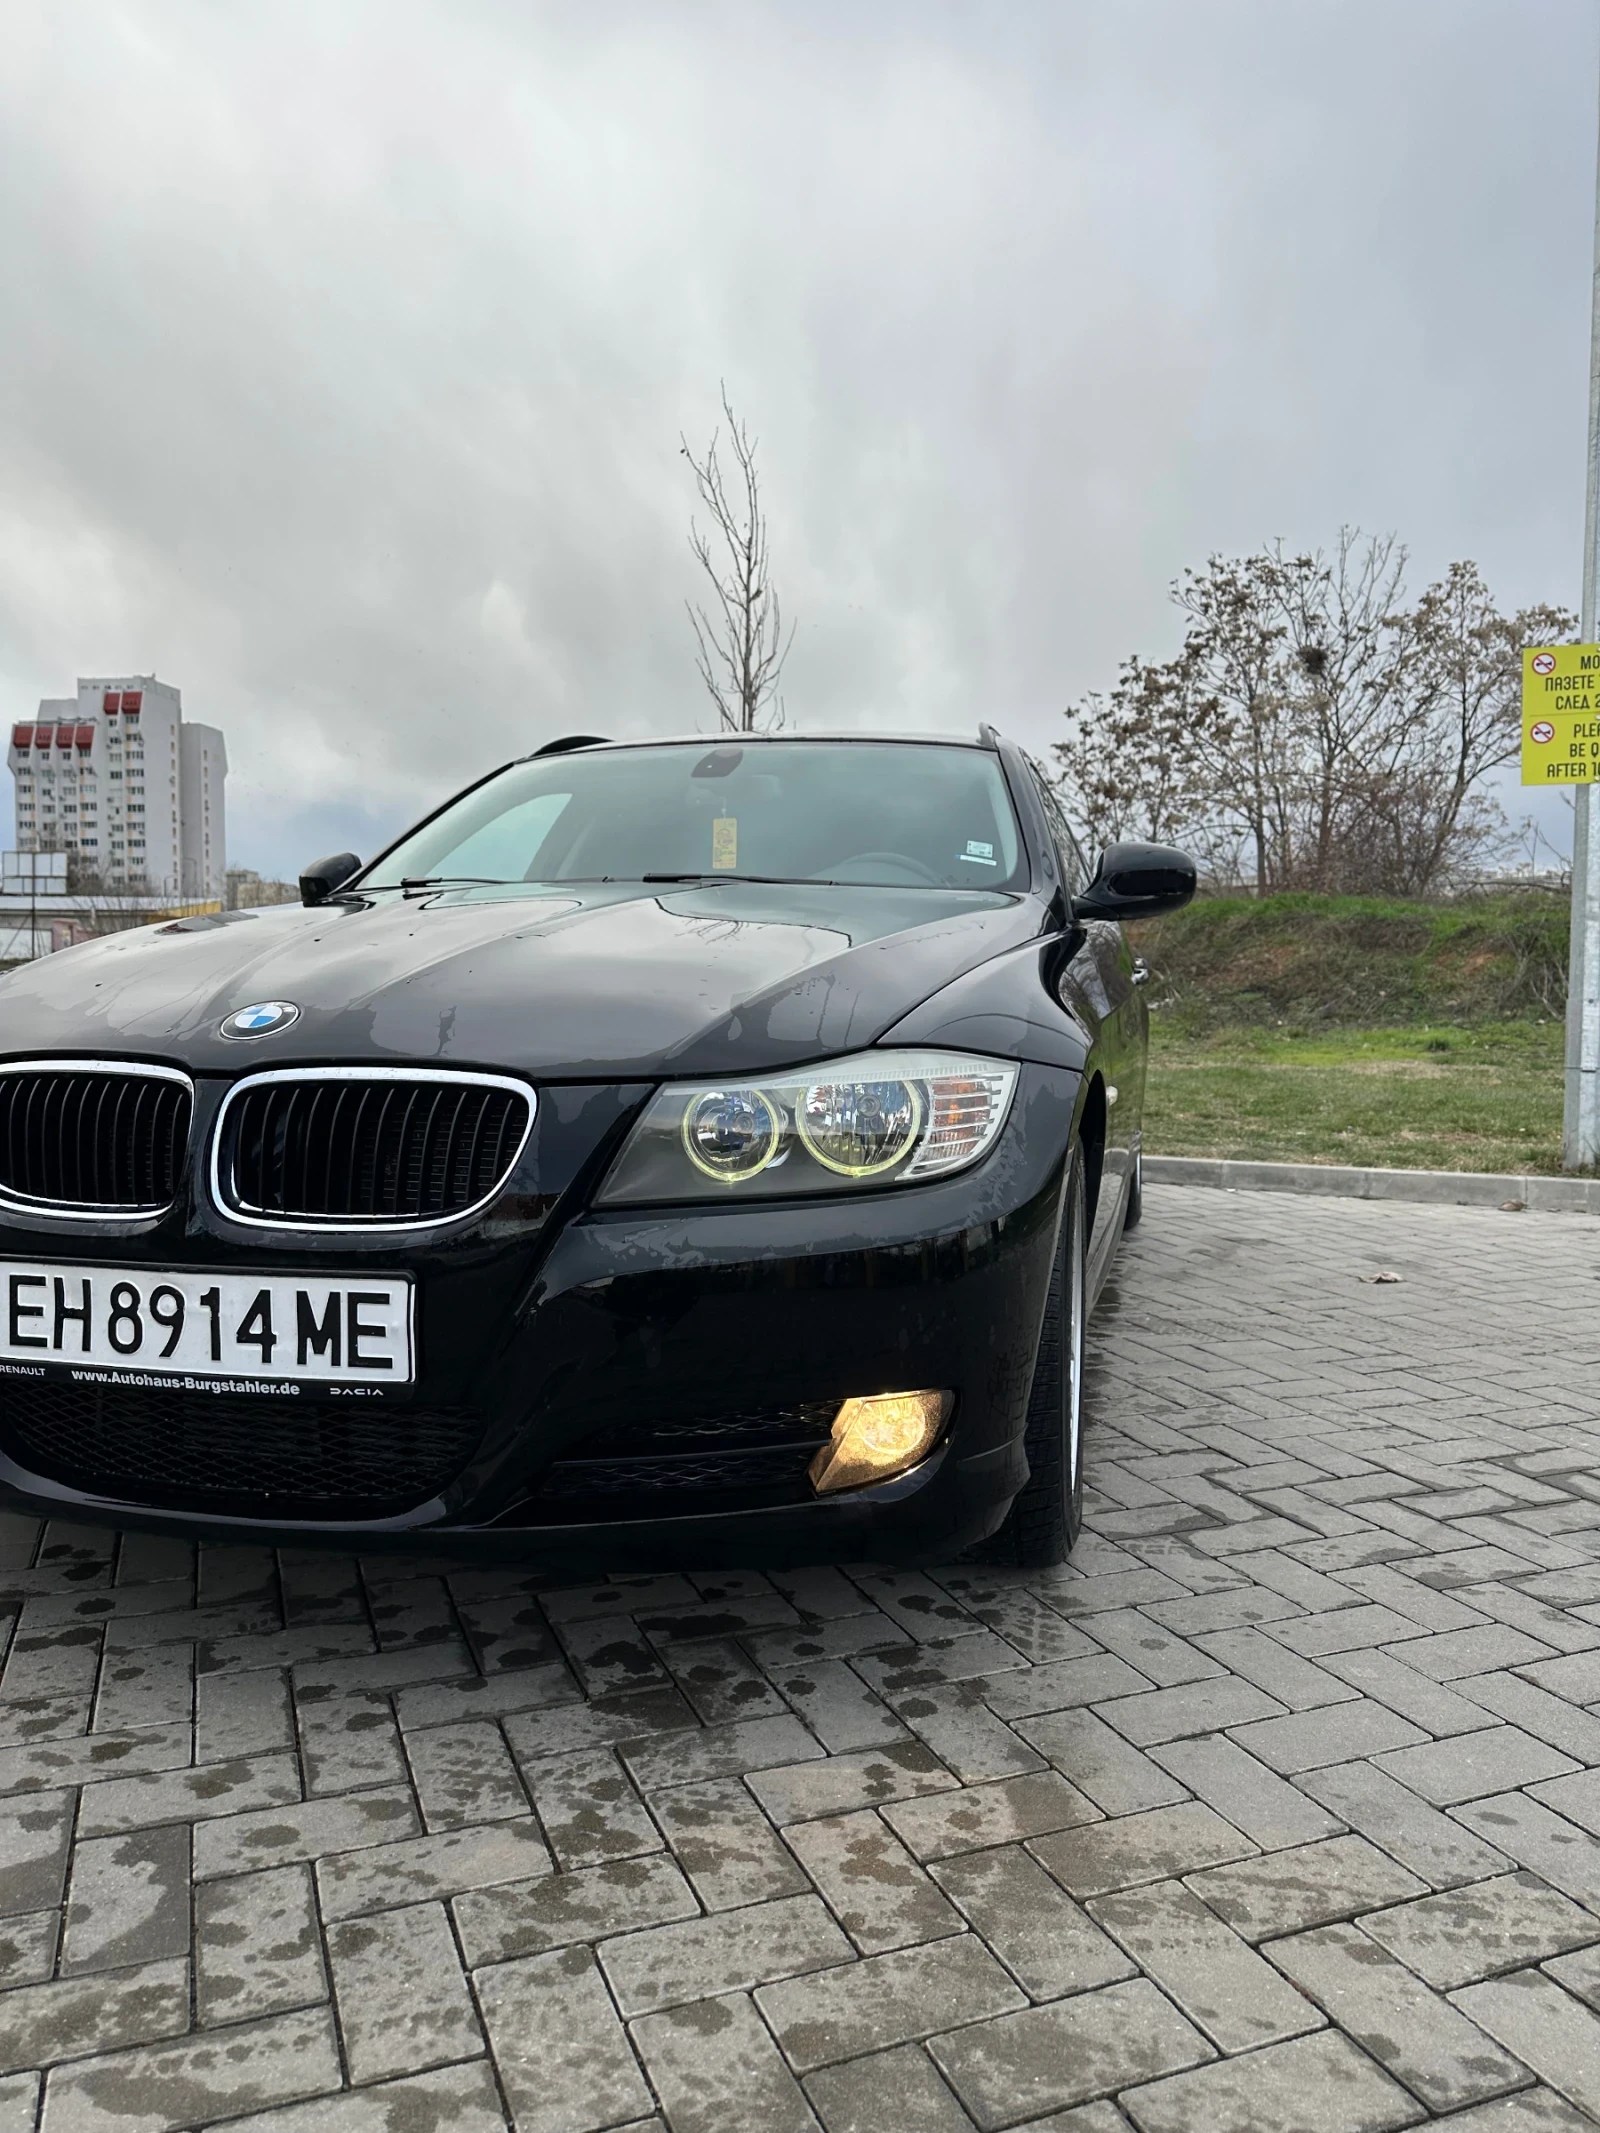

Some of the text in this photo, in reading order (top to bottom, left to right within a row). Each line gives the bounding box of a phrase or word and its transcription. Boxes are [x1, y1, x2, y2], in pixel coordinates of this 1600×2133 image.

[1545, 674, 1595, 692] ПАЗЕТЕ
[1555, 694, 1590, 710] СЛЕД
[1570, 743, 1586, 757] BE
[1547, 762, 1586, 778] AFTER
[0, 1364, 46, 1376] RENAULT
[71, 1369, 300, 1395] www.Autohaus-Burgstahler.de
[329, 1387, 384, 1396] DACIA
